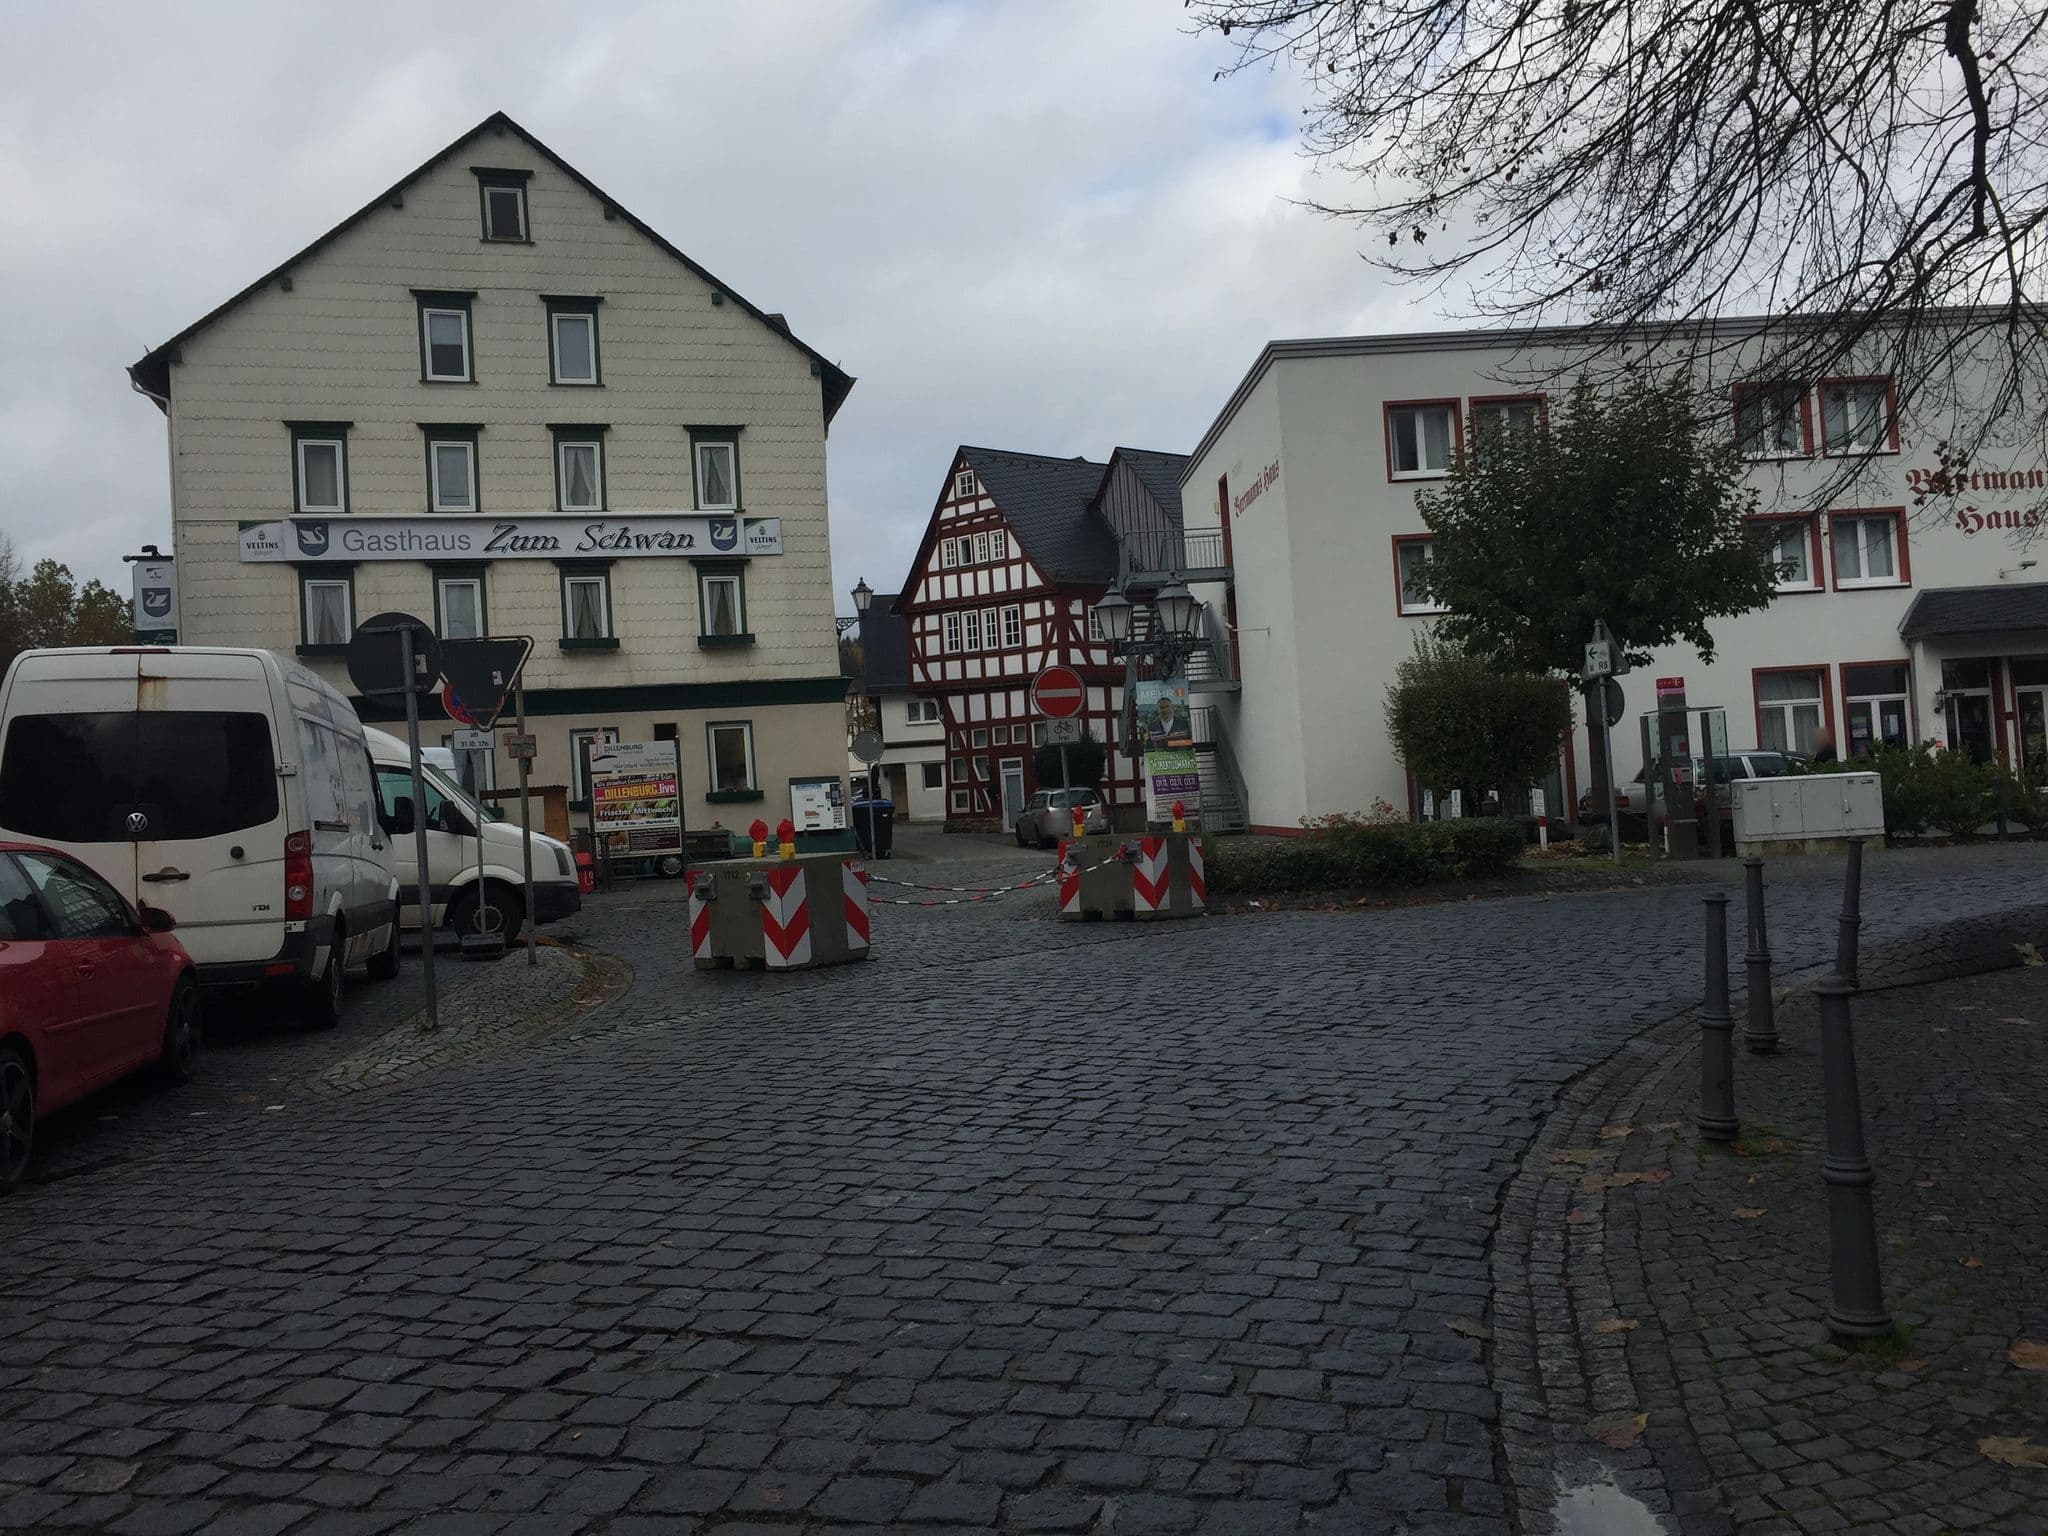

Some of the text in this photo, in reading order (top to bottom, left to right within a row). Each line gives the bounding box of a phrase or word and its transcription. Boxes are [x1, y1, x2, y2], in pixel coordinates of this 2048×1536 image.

[343, 523, 696, 553] Gasthaus Zum Schwan
[749, 536, 777, 545] VELTINS
[246, 541, 279, 550] VELTINS
[1058, 734, 1070, 742] frei
[599, 809, 631, 817] Frischer
